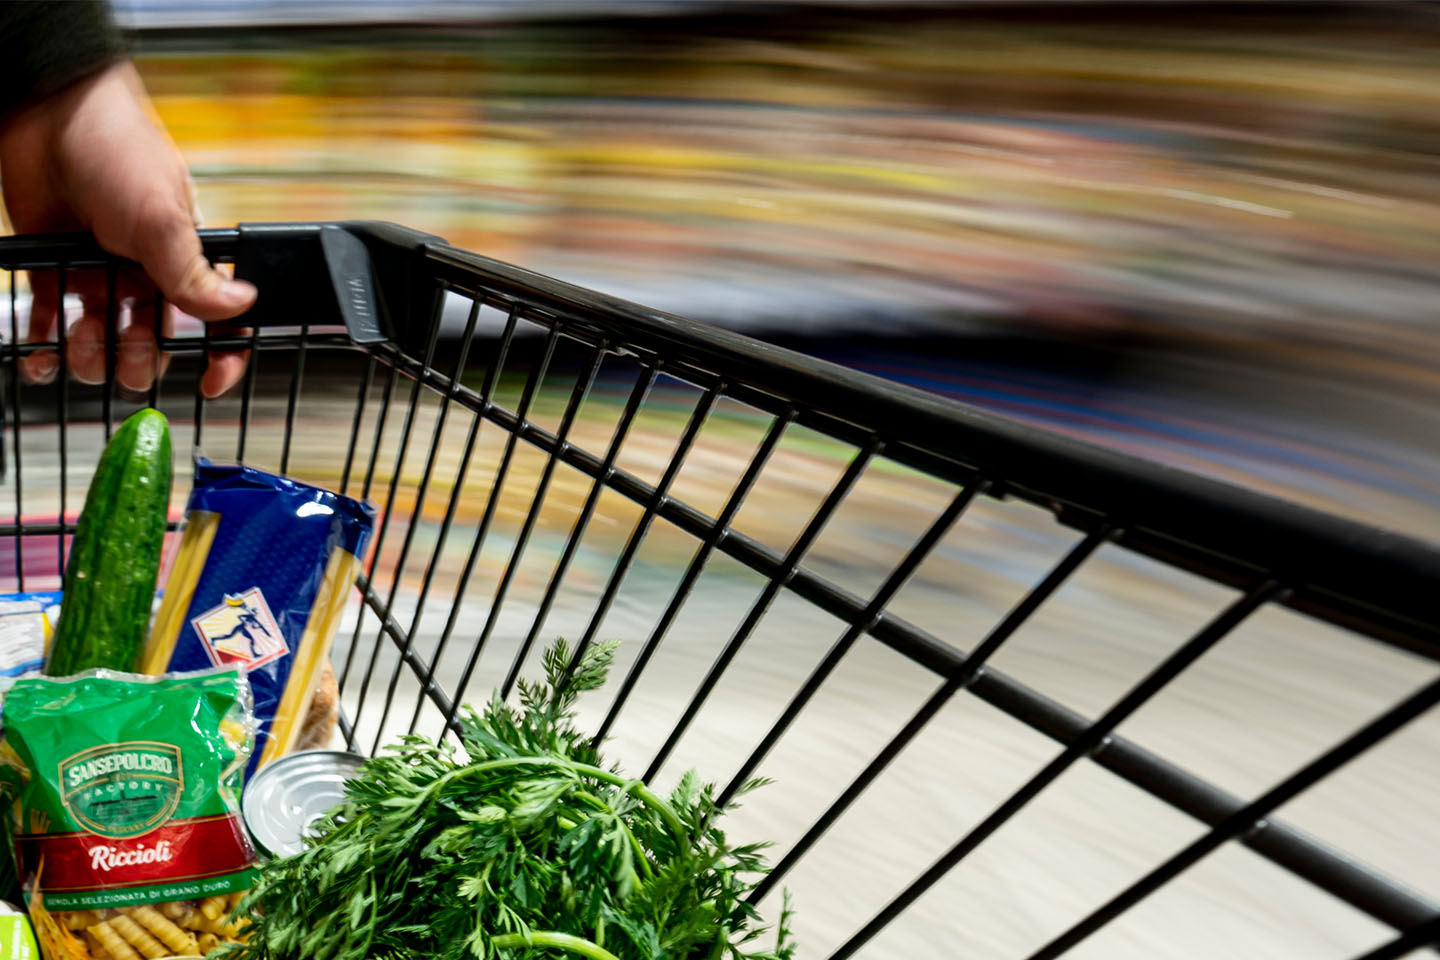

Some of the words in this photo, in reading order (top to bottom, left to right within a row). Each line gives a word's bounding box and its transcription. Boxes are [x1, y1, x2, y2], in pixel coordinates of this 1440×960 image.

[68, 753, 173, 787] SANSEPOLCRO
[84, 782, 164, 801] FACTORY
[89, 841, 173, 871] Riccioli
[81, 892, 146, 905] SELEZIONATA
[149, 889, 162, 899] DI
[164, 885, 200, 898] GRANO
[203, 880, 231, 890] DURO
